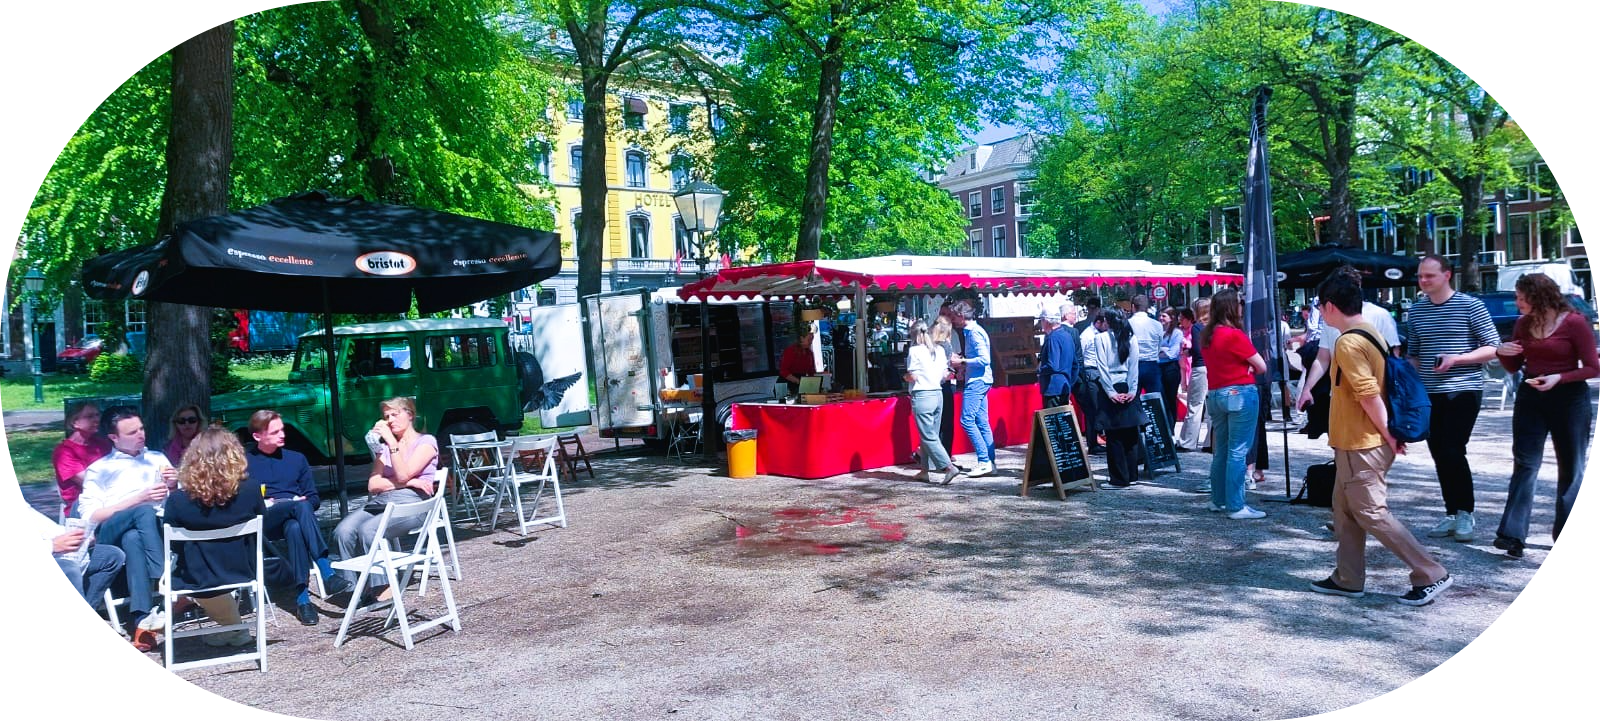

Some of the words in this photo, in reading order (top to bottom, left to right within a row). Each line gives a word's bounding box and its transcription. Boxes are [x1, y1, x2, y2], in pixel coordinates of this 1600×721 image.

[635, 192, 671, 207] HOTEL
[268, 255, 314, 265] eccellente
[367, 257, 405, 269] bristot
[1422, 580, 1444, 597] Polo
